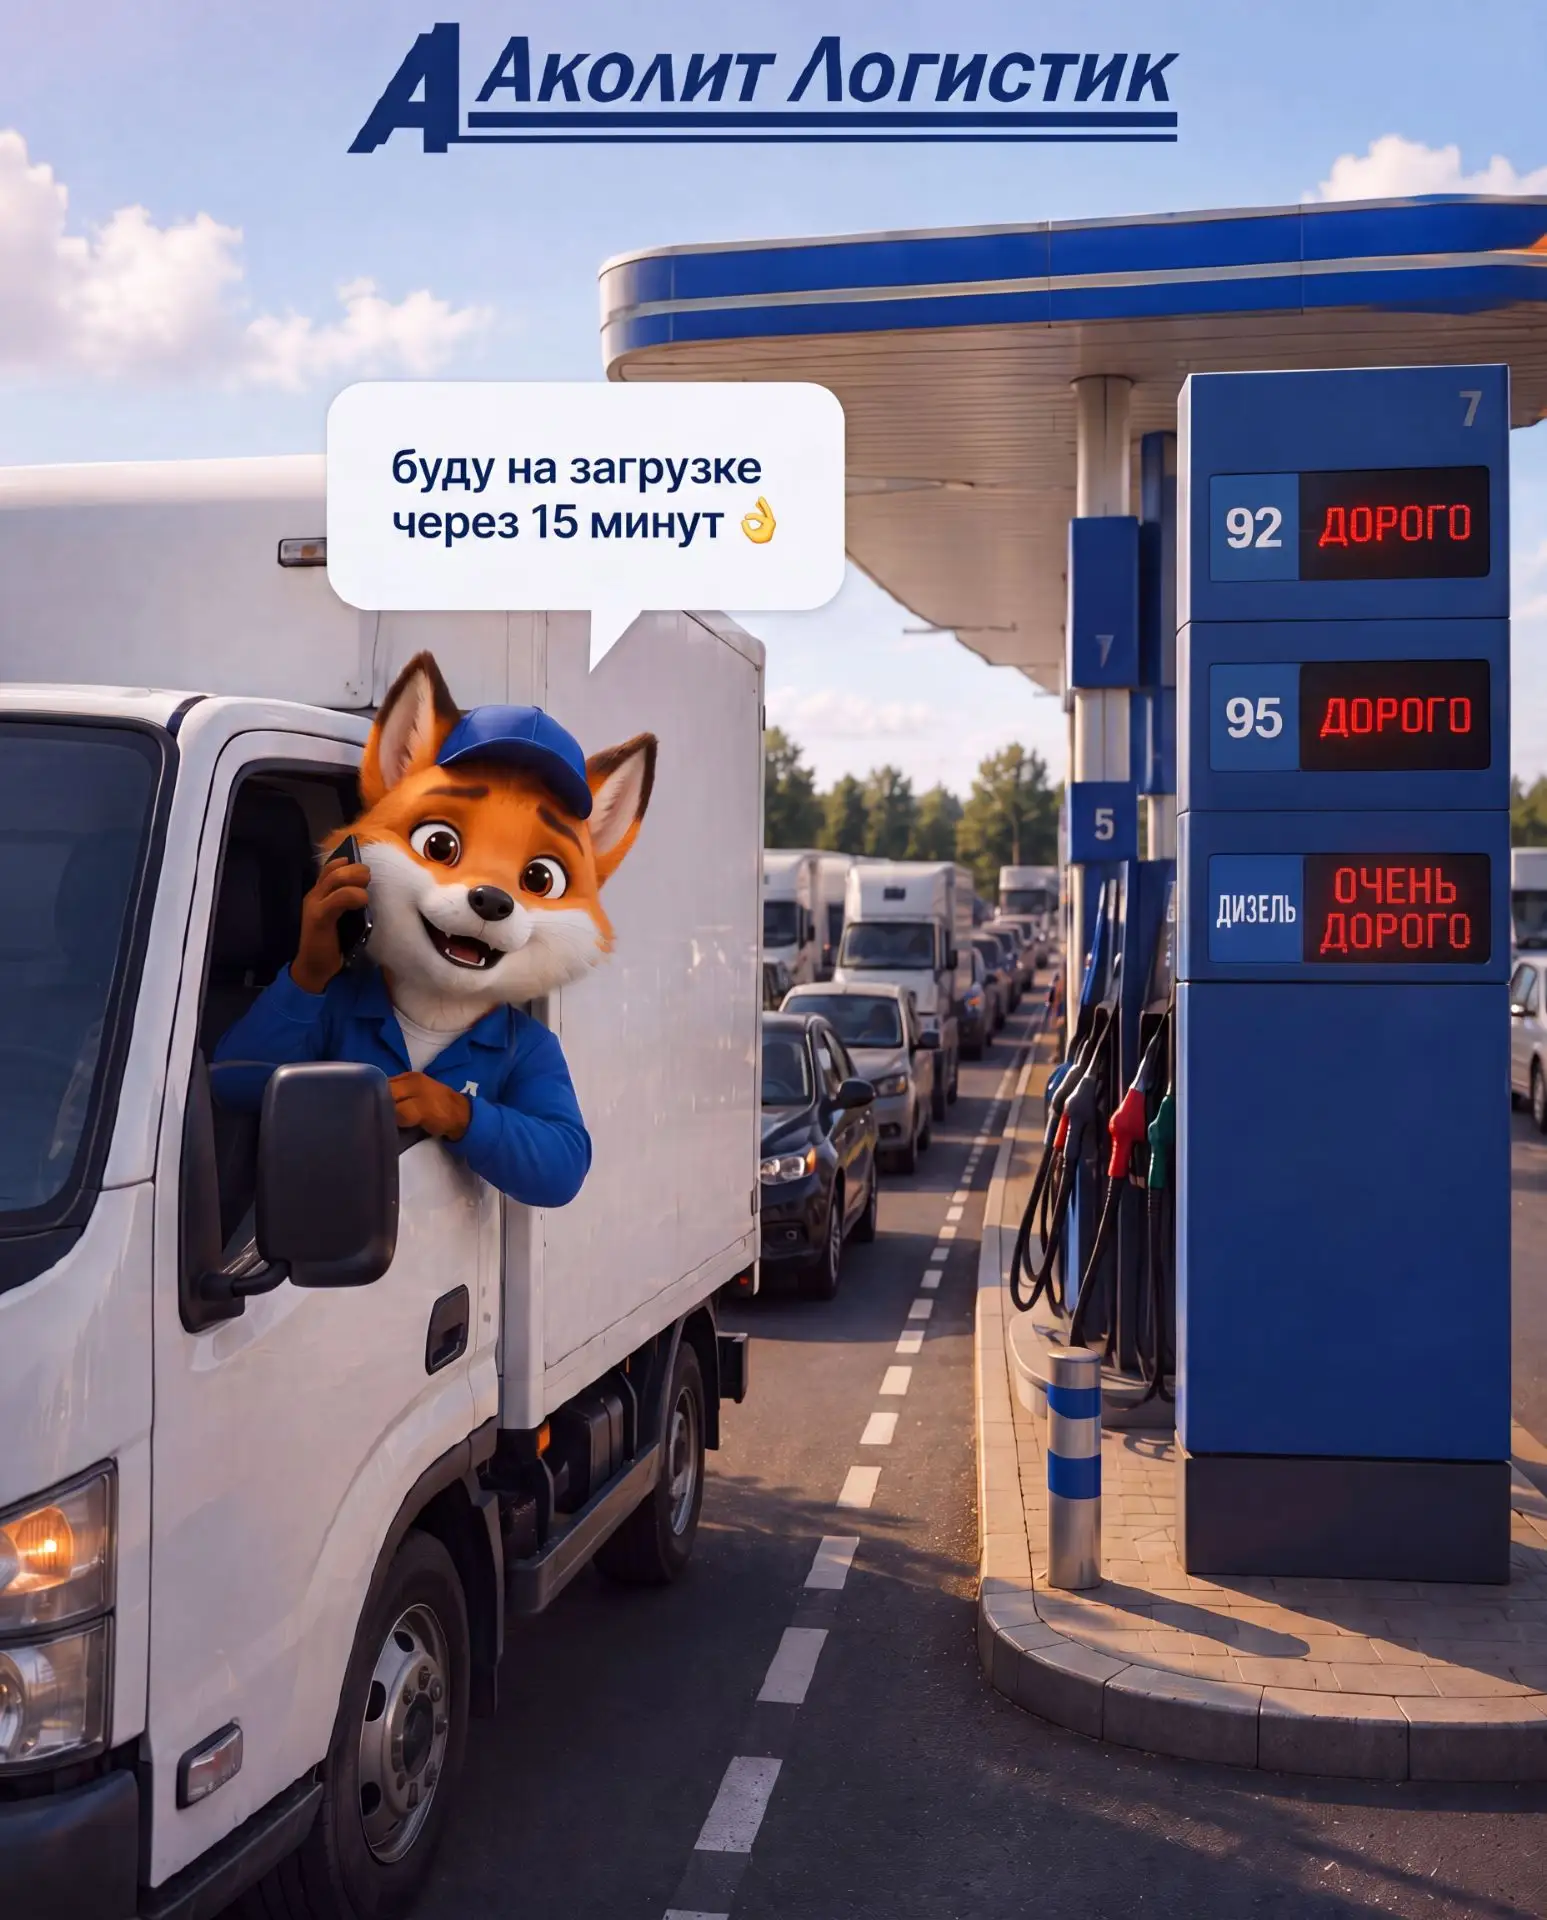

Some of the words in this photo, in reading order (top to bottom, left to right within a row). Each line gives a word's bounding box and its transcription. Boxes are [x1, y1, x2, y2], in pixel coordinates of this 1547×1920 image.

[1458, 390, 1483, 427] 7
[1226, 506, 1283, 549] 92
[1318, 503, 1472, 548] ДОРОГО
[1226, 697, 1283, 739] 95
[1318, 696, 1472, 738] ДОРОГО
[1094, 808, 1115, 840] 5
[1333, 866, 1458, 905] ОЧЕНЬ
[1216, 893, 1297, 930] ДИЗЕЛЬ
[1318, 910, 1472, 955] ДОРОГО
